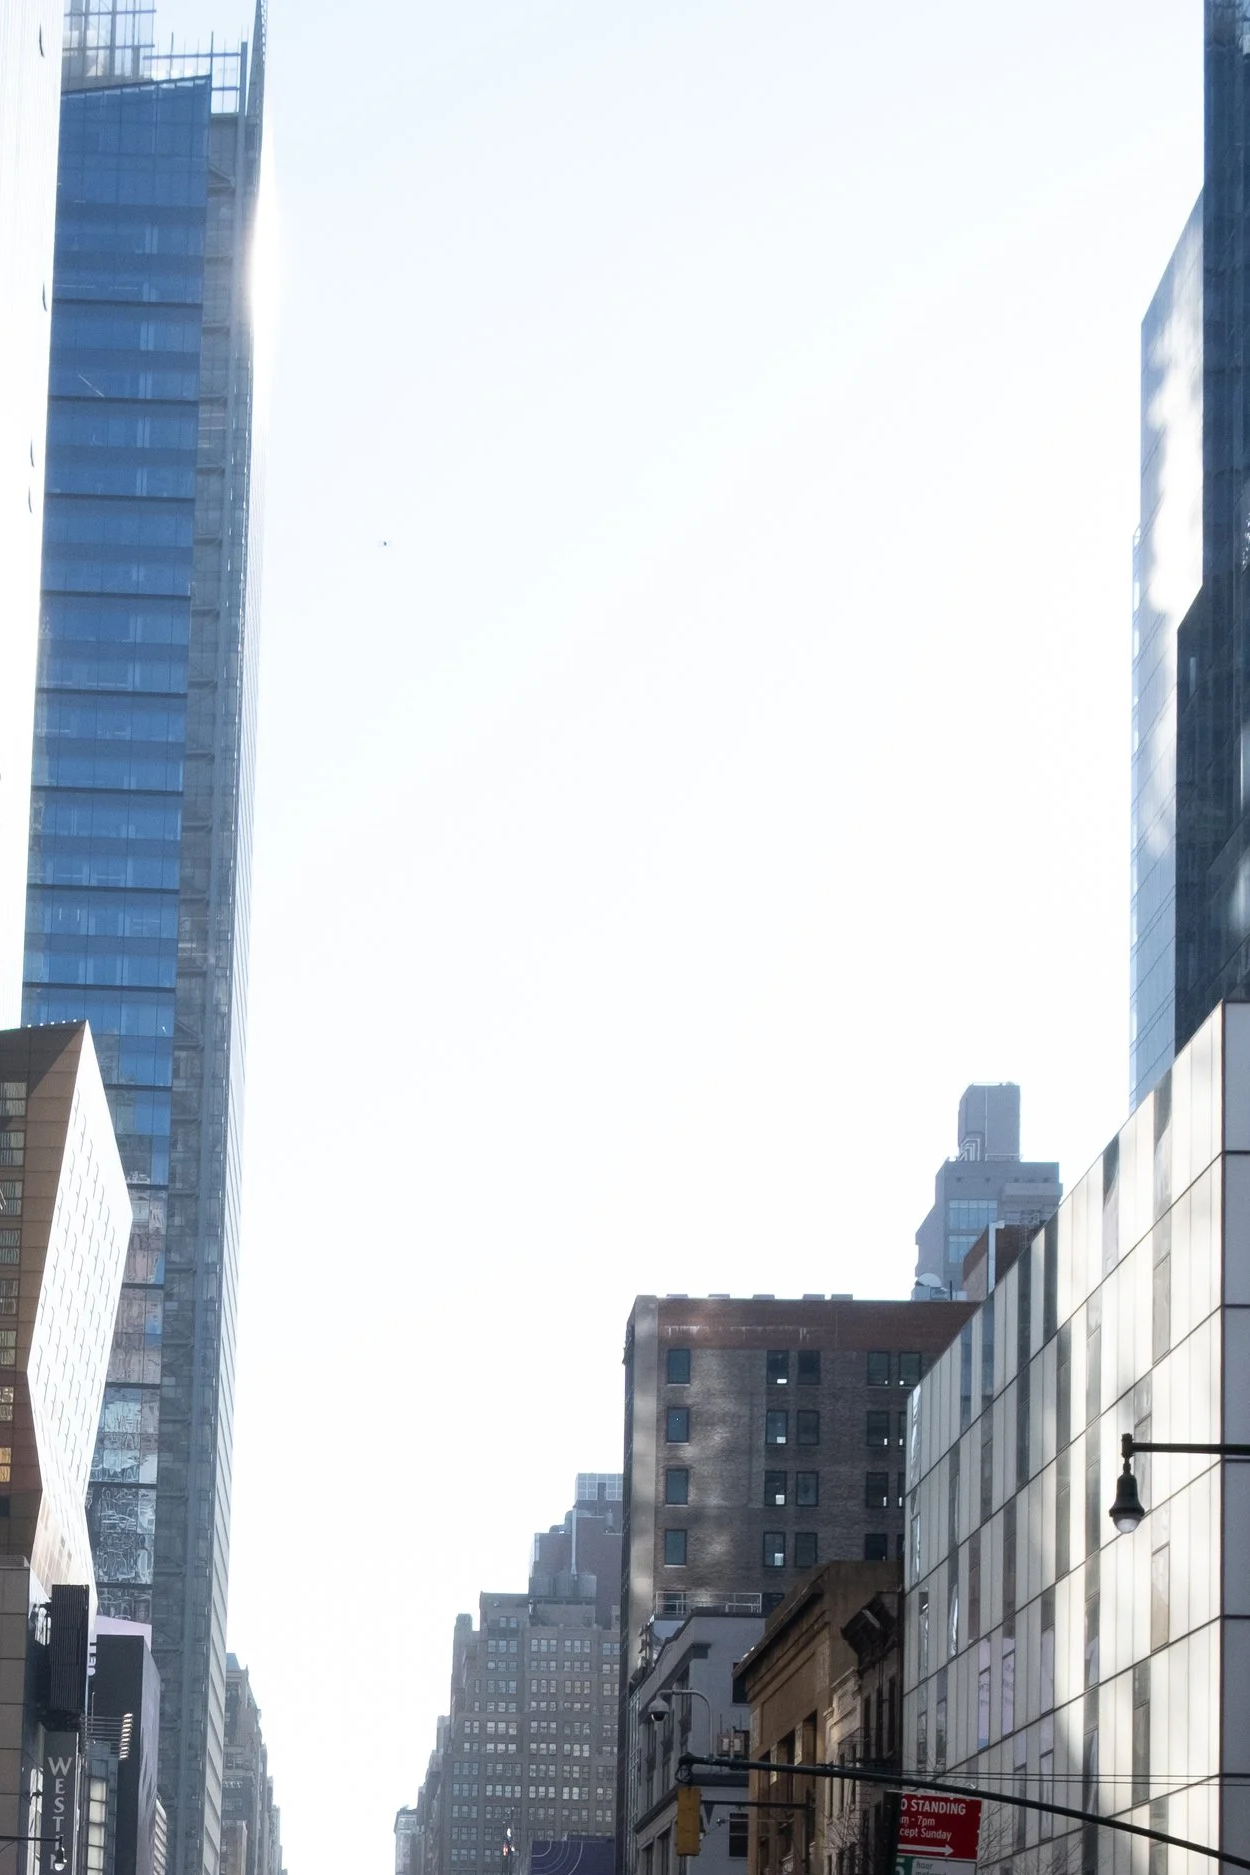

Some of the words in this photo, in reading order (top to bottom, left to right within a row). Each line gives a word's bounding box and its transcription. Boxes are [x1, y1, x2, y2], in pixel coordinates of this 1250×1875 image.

[48, 1756, 73, 1869] WEST
[909, 1801, 967, 1816] STANDING
[917, 1816, 936, 1827] 7pm
[921, 1828, 953, 1842] Sunday
[915, 1861, 934, 1870] hour
